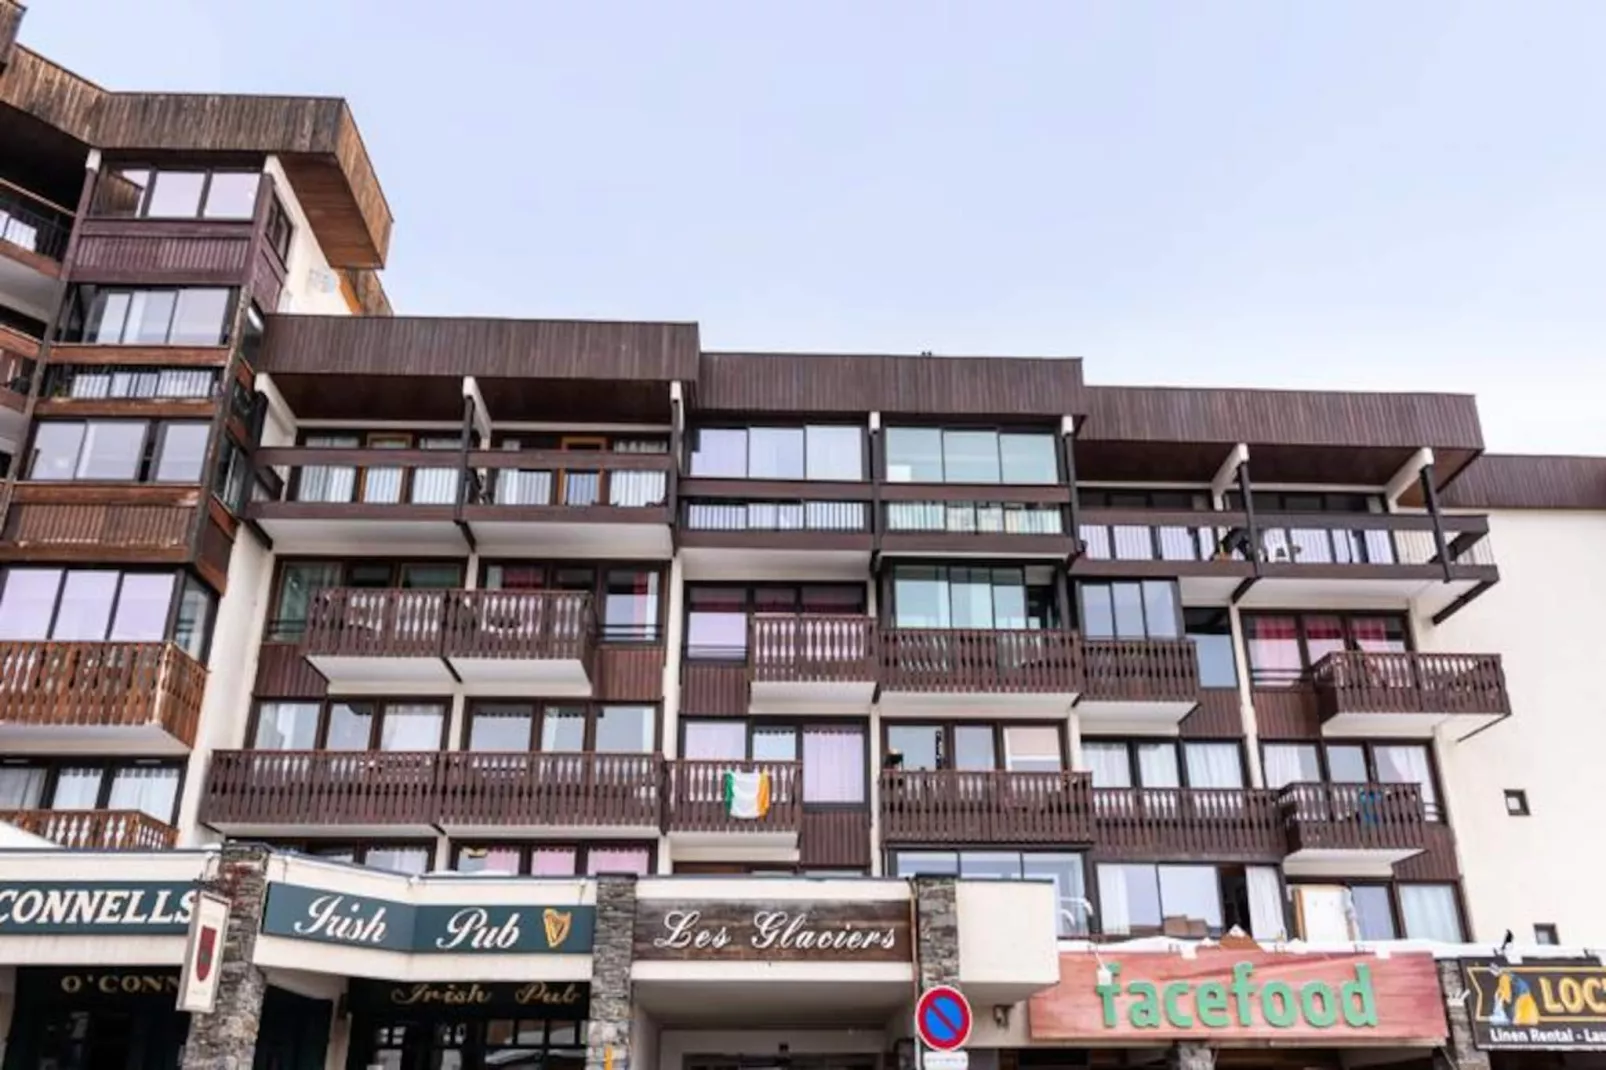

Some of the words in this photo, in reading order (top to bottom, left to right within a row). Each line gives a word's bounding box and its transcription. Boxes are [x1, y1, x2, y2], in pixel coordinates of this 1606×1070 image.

[294, 895, 387, 943] Irish
[436, 906, 520, 949] Pub
[653, 911, 731, 949] Les
[750, 911, 896, 949] Glaciers
[391, 984, 493, 1005] Irish
[514, 981, 581, 1005] Pub
[1096, 961, 1378, 1029] facefood
[1490, 1028, 1529, 1042] Linen
[1529, 1028, 1575, 1042] Rental
